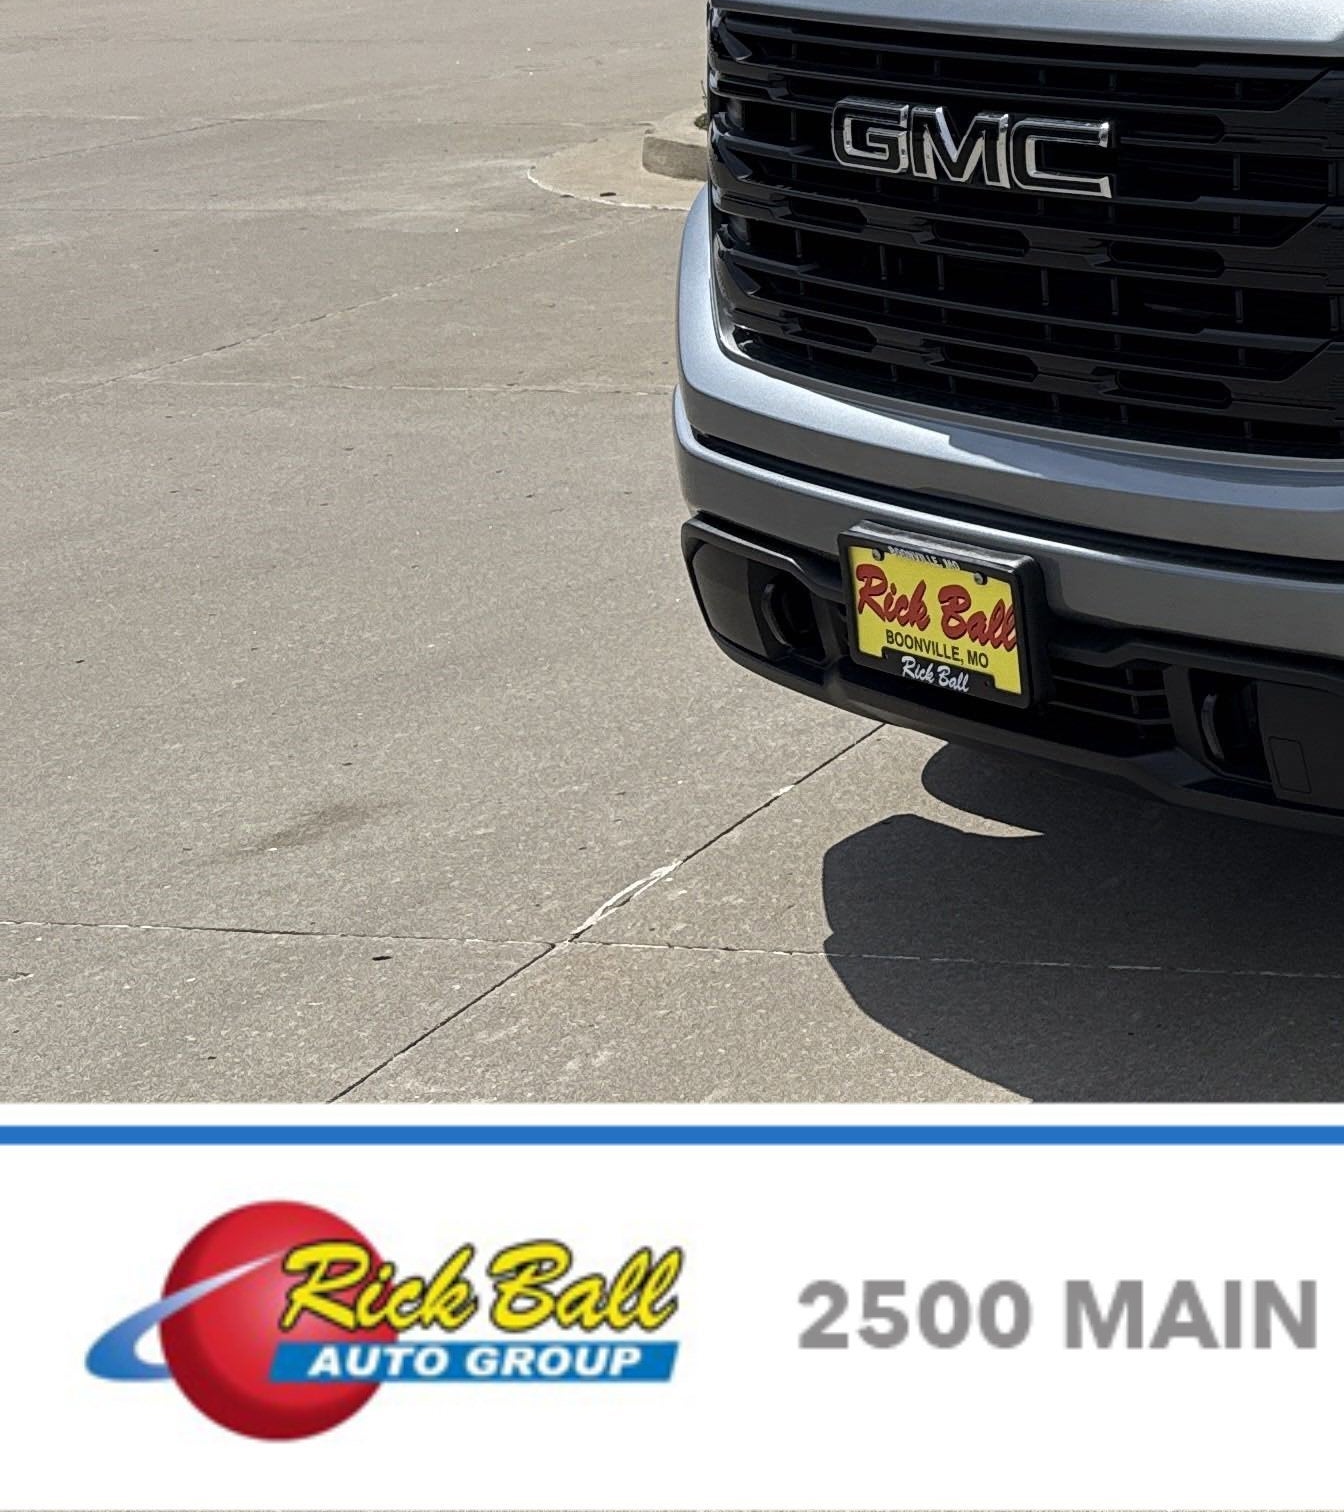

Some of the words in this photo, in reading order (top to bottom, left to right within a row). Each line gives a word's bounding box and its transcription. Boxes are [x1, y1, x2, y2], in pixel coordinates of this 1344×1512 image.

[832, 96, 1112, 198] GMC
[855, 563, 931, 631] Rick
[937, 584, 1017, 652] Ball
[885, 629, 964, 666] BOONVILLE,
[967, 649, 989, 669] MO
[901, 656, 935, 684] Rick
[937, 665, 970, 693] Ball
